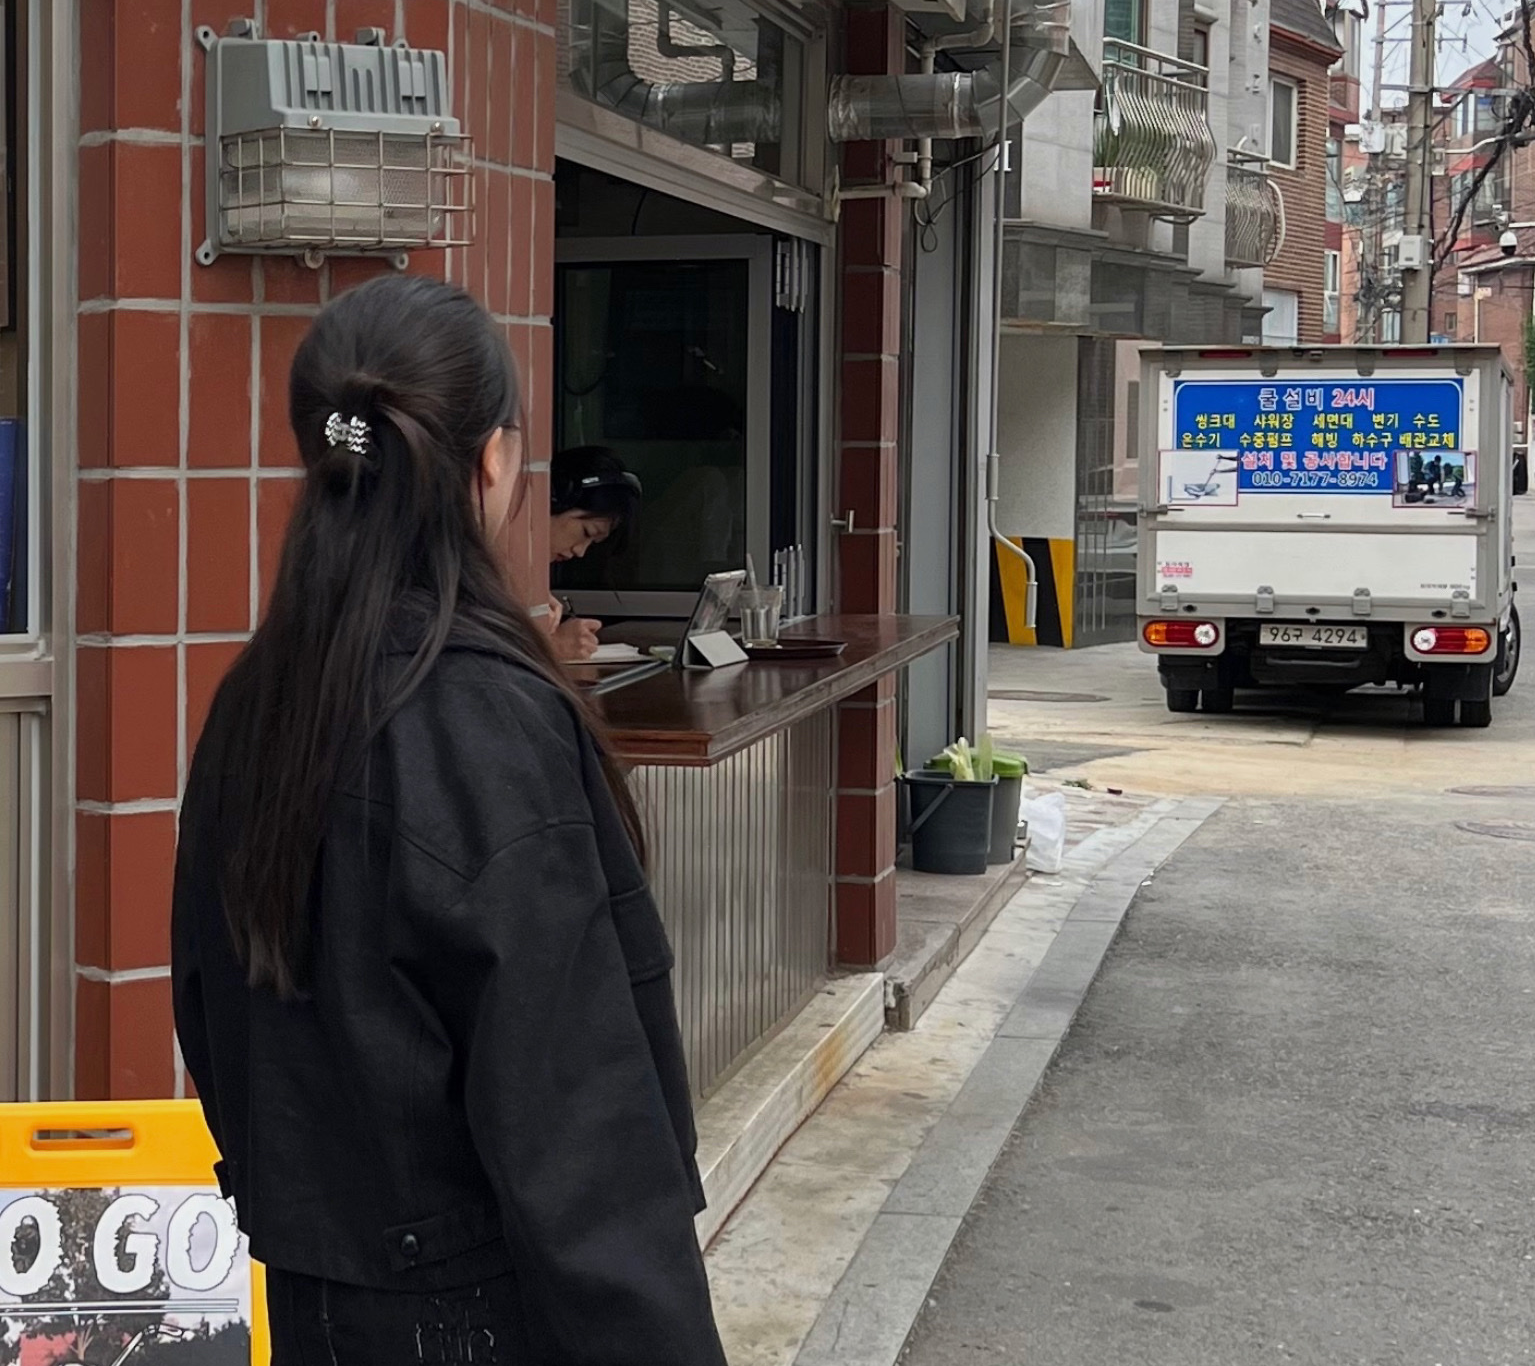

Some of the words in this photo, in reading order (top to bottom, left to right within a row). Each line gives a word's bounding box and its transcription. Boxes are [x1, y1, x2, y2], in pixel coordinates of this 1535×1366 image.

[1331, 387, 1375, 411] 24시
[1313, 413, 1353, 429] 세면대
[1372, 413, 1399, 429] 변기
[1412, 413, 1441, 428] 수도
[1181, 432, 1221, 448] 온수기
[1352, 432, 1393, 448] 하수구
[1241, 451, 1274, 470] 설치
[1302, 451, 1388, 470] 공사합니다
[1252, 470, 1379, 487] 010-7177-8974
[1269, 626, 1303, 642] 96구
[1311, 628, 1358, 644] 4294
[92, 1192, 242, 1294] GO
